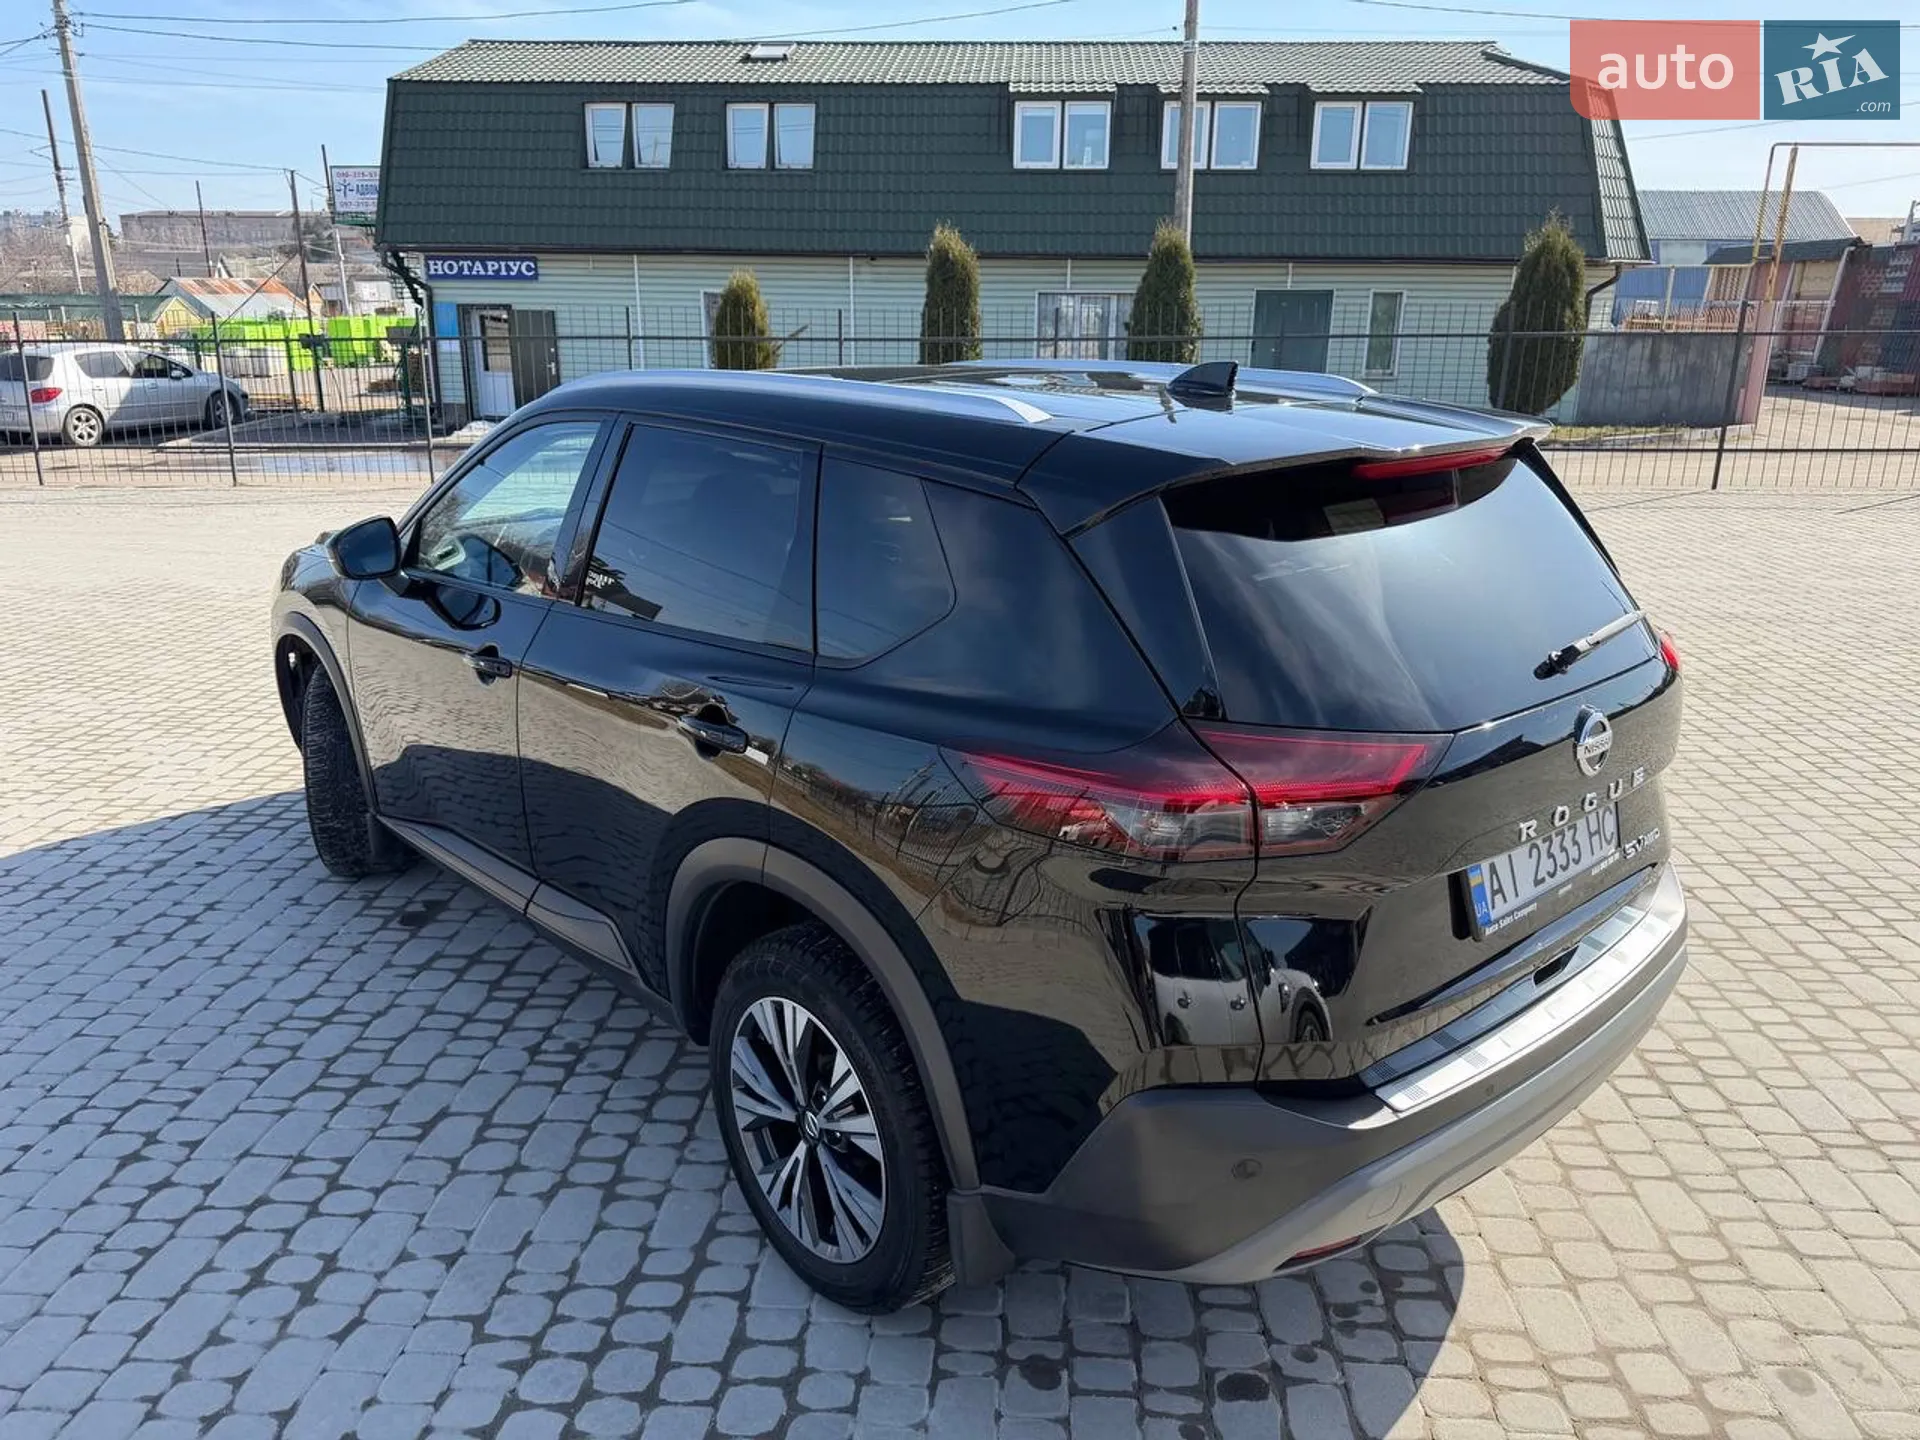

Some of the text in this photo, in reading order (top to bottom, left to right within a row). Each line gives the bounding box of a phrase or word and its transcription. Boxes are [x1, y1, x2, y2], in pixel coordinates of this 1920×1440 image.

[428, 260, 536, 276] НОТАРІУС
[1519, 767, 1645, 842] ROGUE
[1488, 854, 1519, 910] AI
[1529, 823, 1581, 887] 2333
[1586, 807, 1614, 856] HC
